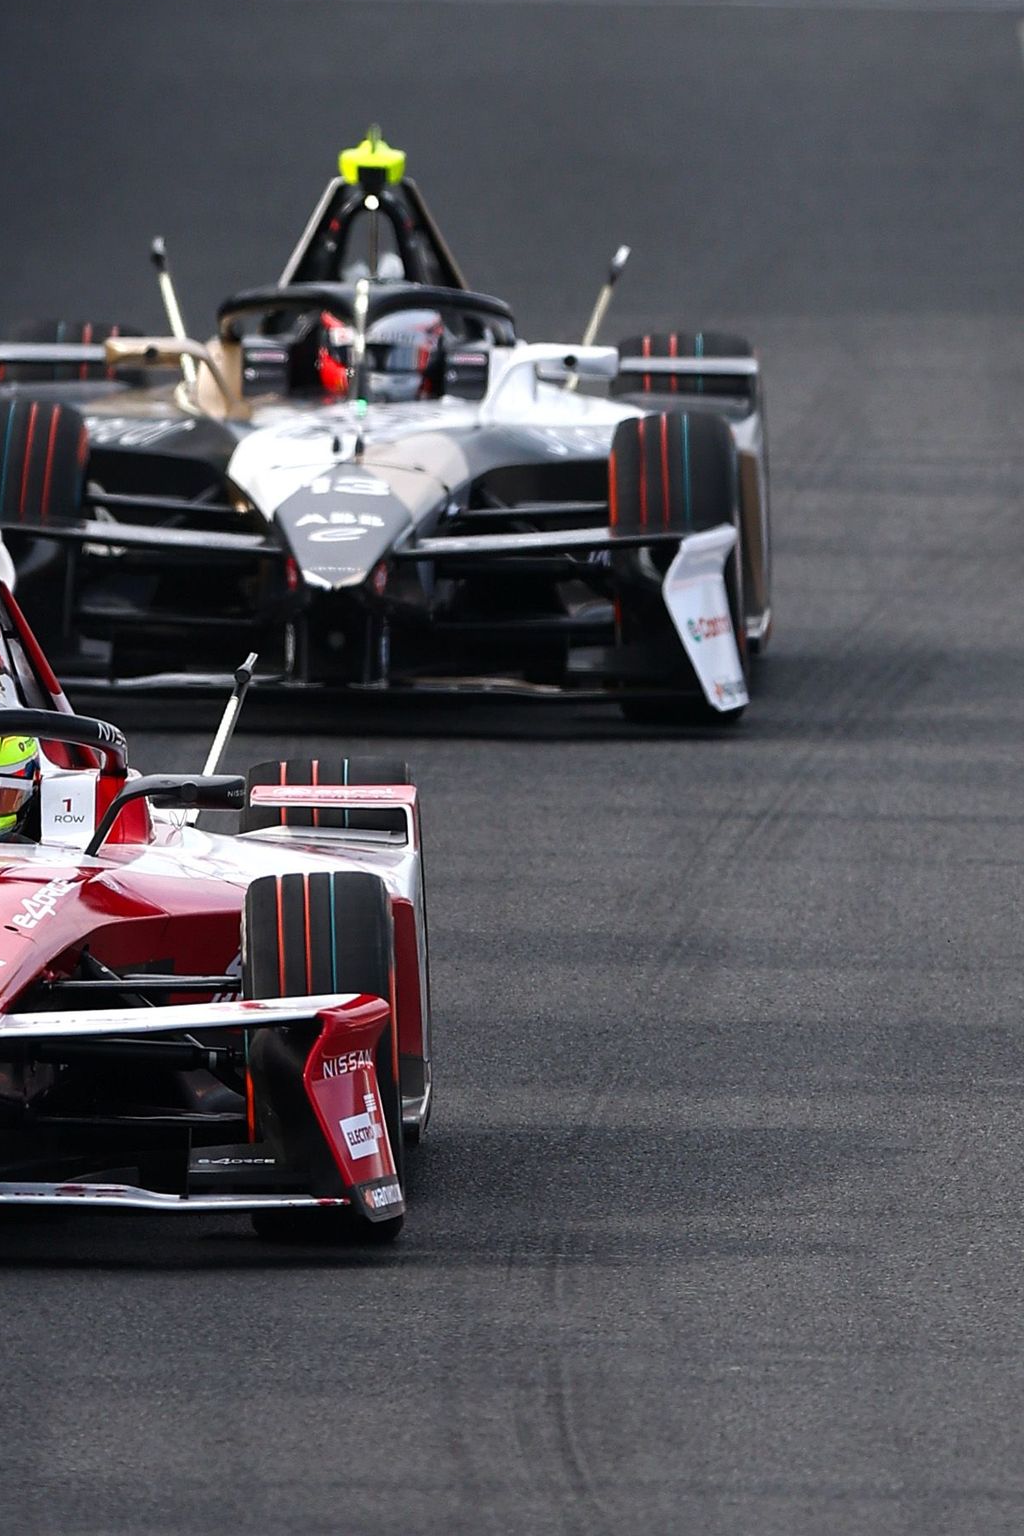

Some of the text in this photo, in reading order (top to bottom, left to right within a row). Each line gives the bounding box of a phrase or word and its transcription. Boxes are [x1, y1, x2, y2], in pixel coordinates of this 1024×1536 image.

[62, 799, 72, 812] 1
[54, 815, 85, 823] ROW
[322, 1048, 374, 1080] NISSAN
